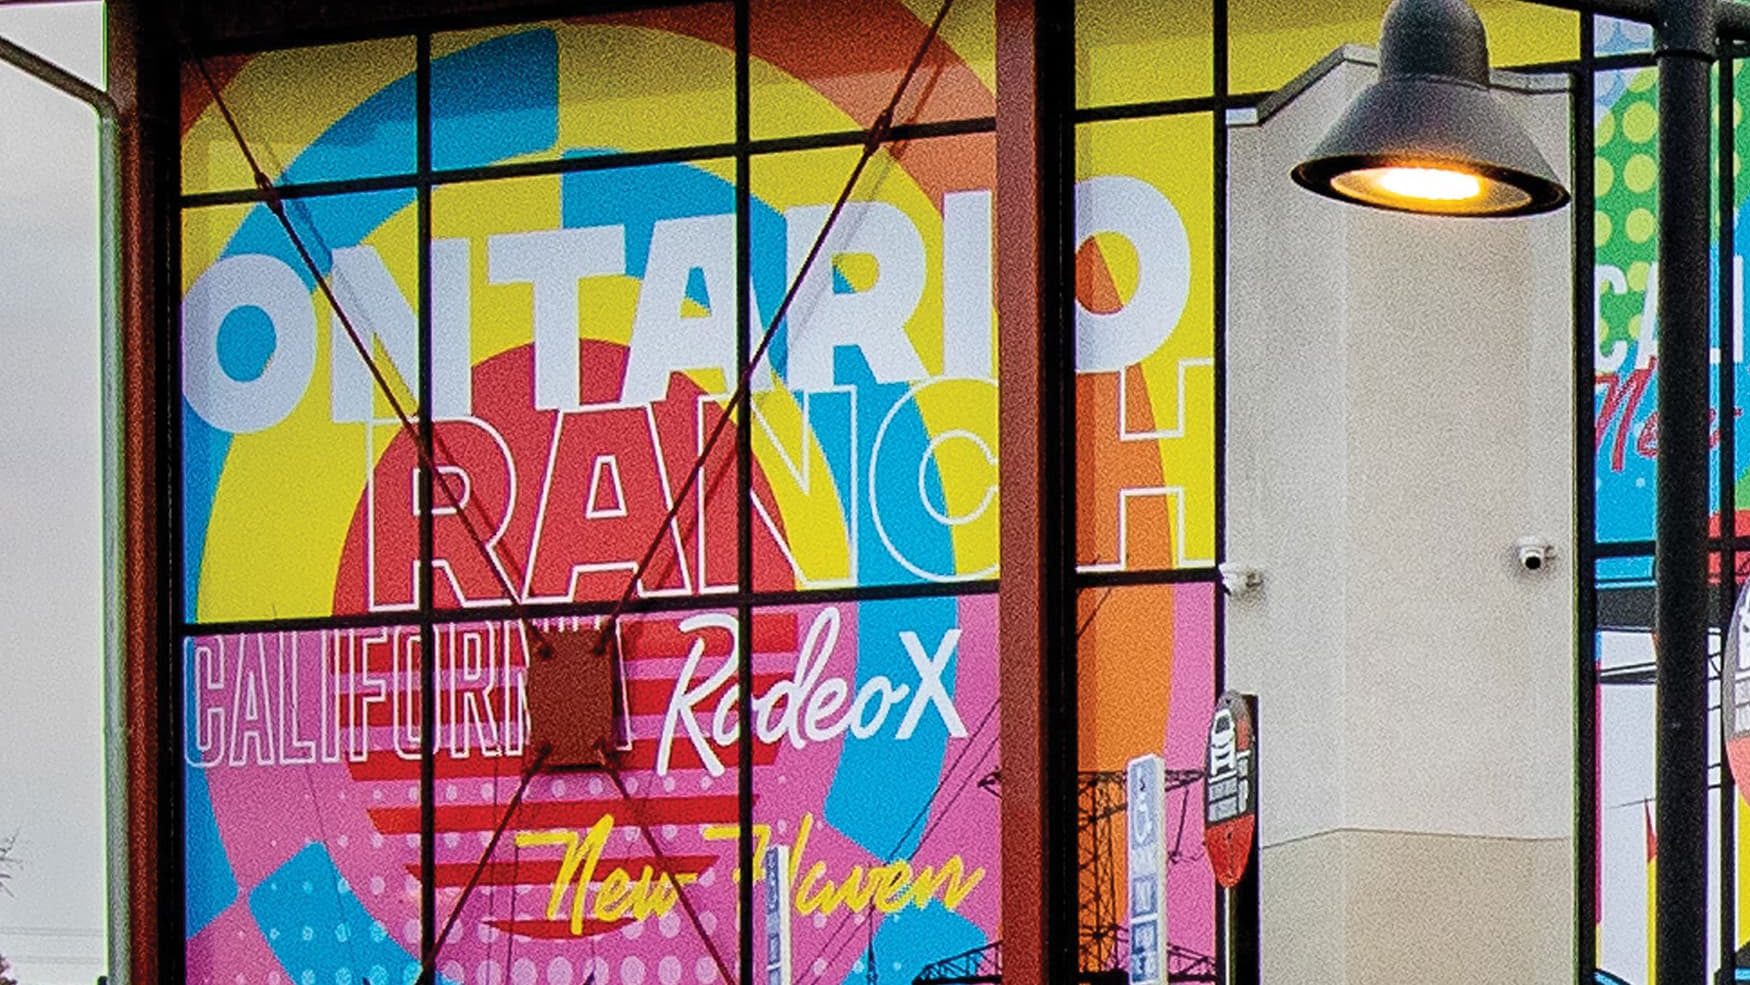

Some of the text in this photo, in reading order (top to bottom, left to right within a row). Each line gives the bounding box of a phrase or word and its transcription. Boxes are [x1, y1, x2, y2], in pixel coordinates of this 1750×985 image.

[181, 174, 1192, 434] ONTARIO
[365, 355, 1215, 612] RANCH
[1593, 352, 1743, 472] Ne
[183, 617, 634, 768] CALIFORN
[656, 606, 968, 778] RodeoX
[515, 812, 987, 935] New Haven
